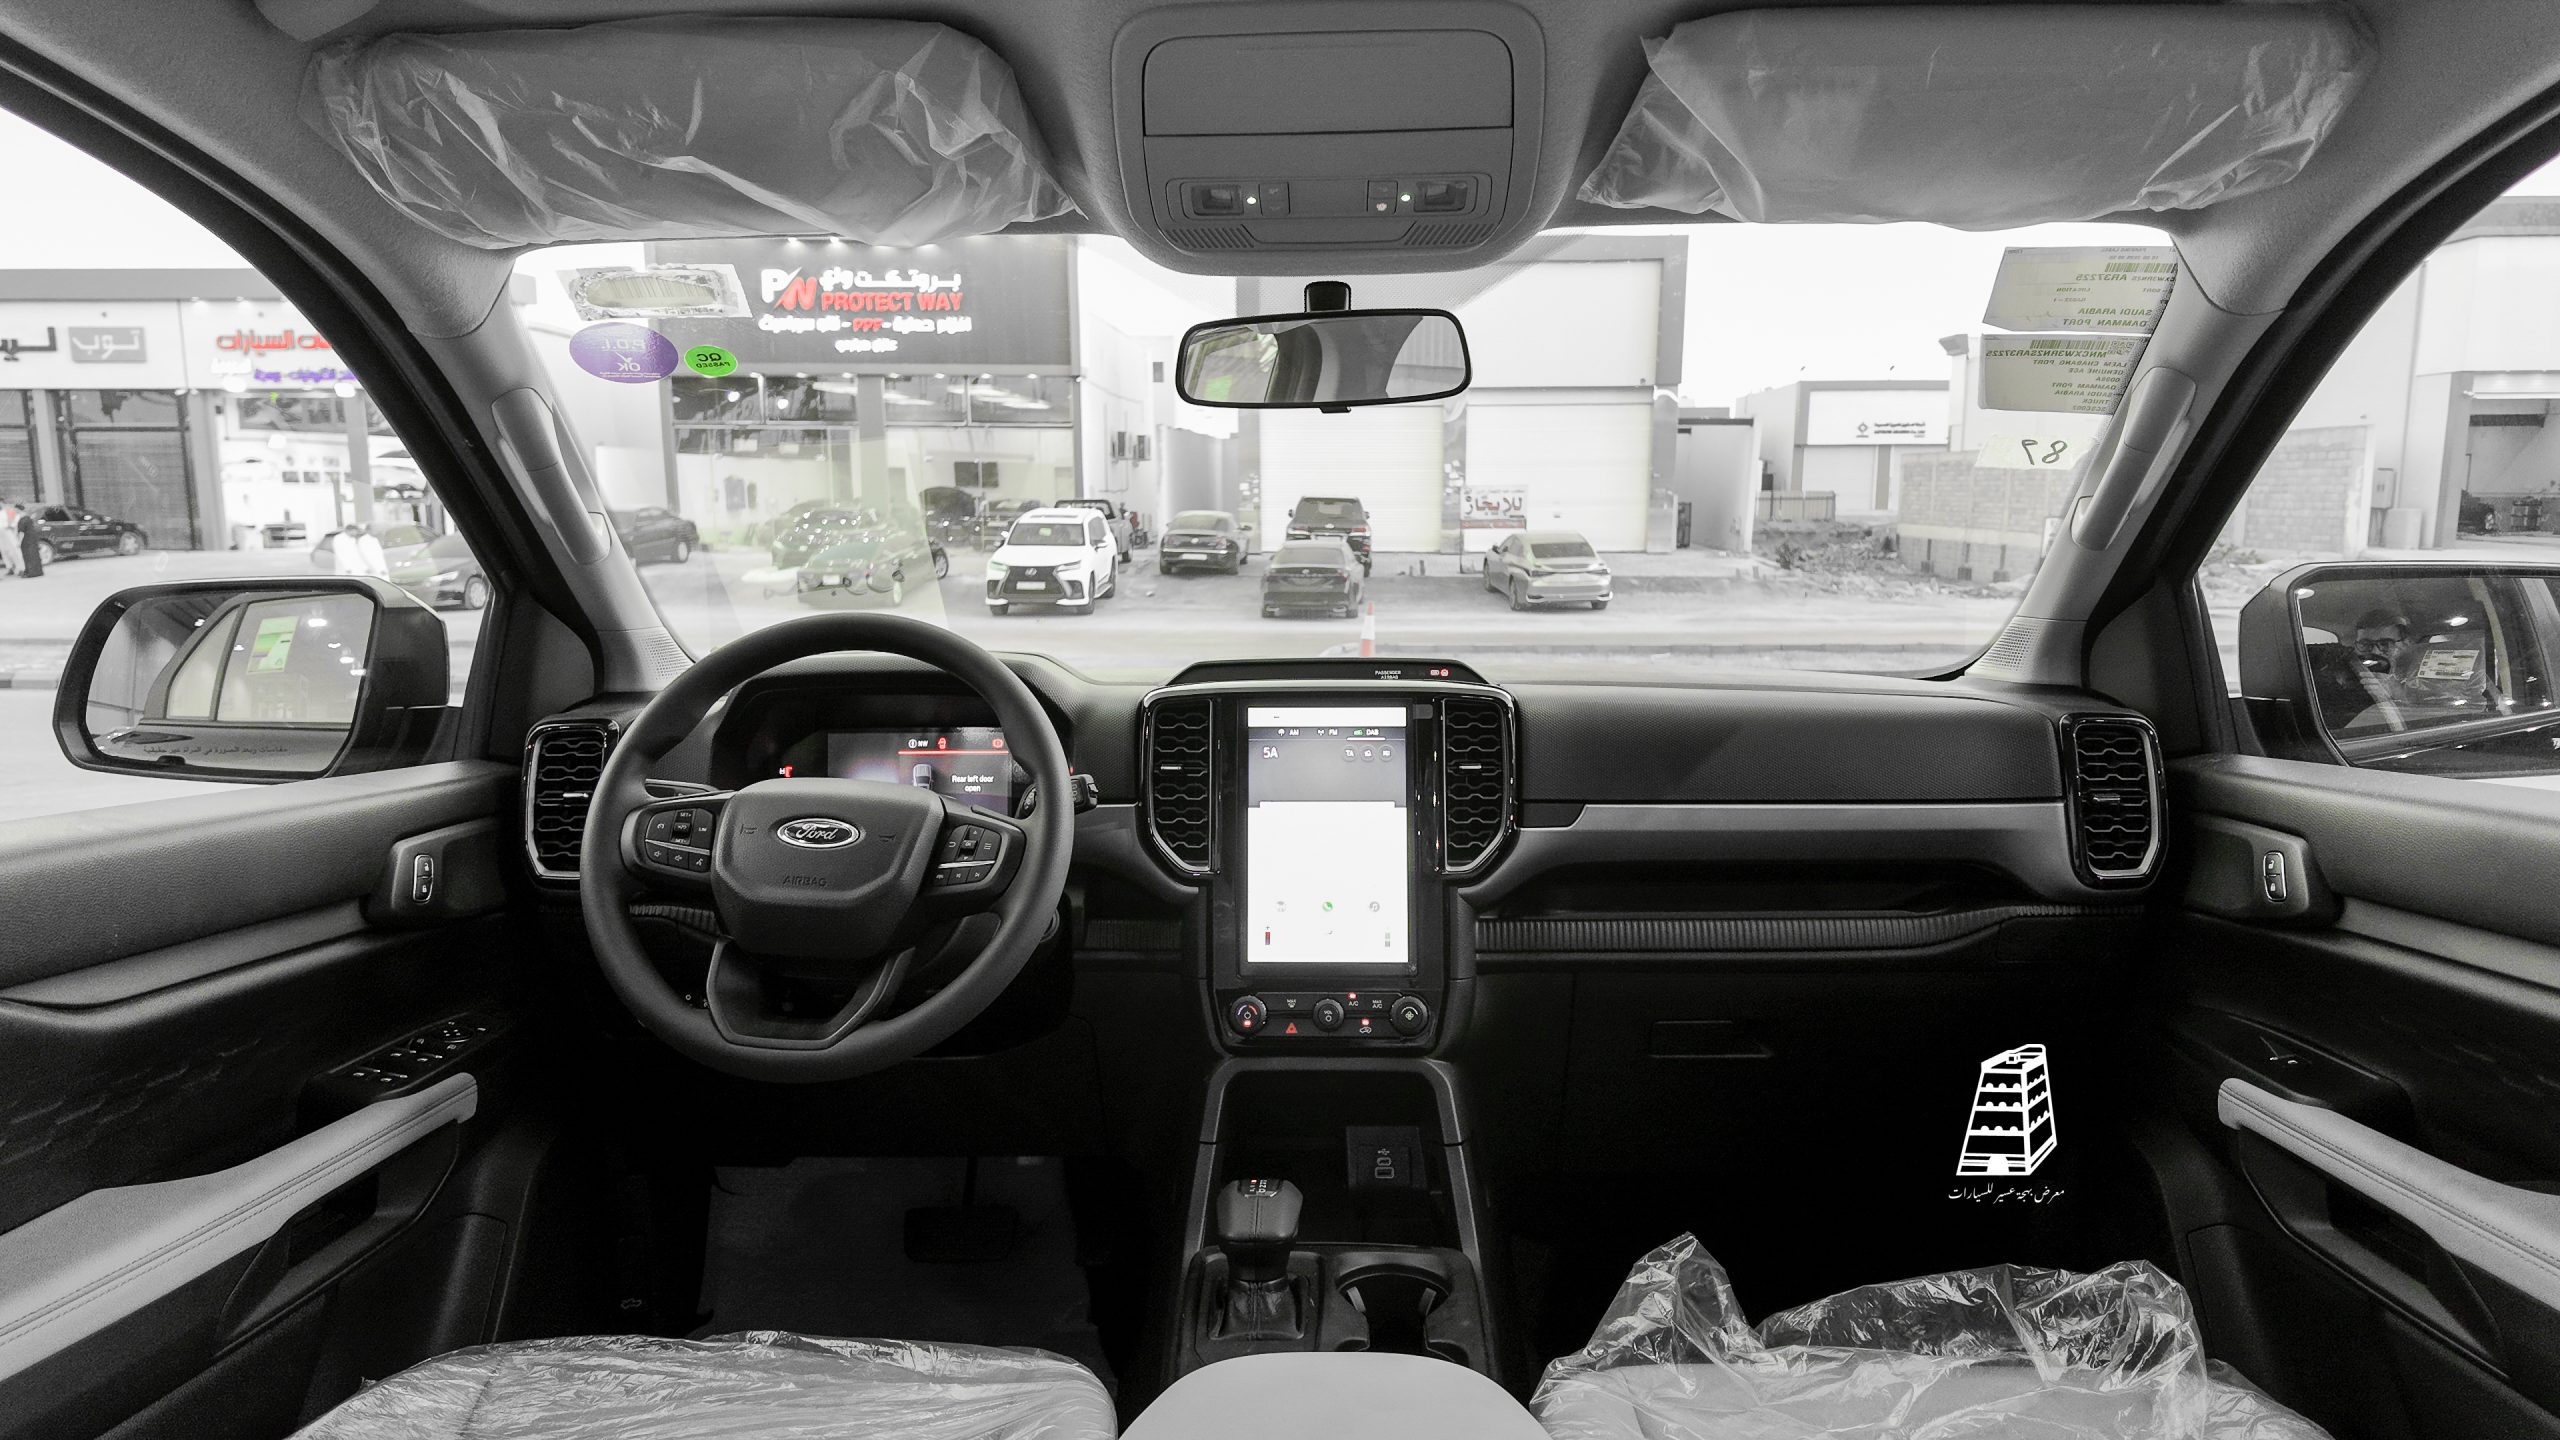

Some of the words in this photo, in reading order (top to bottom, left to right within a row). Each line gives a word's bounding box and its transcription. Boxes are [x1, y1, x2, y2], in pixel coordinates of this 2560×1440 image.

[821, 291, 914, 312] PROTECT
[917, 291, 963, 312] WAY
[72, 329, 141, 360] توب
[216, 329, 294, 357] السيارات
[1263, 746, 1278, 758] 5A
[952, 775, 967, 783] Rear
[979, 775, 994, 783] door
[965, 785, 981, 793] open
[795, 822, 839, 840] Ford
[783, 876, 828, 887] AIRBAG
